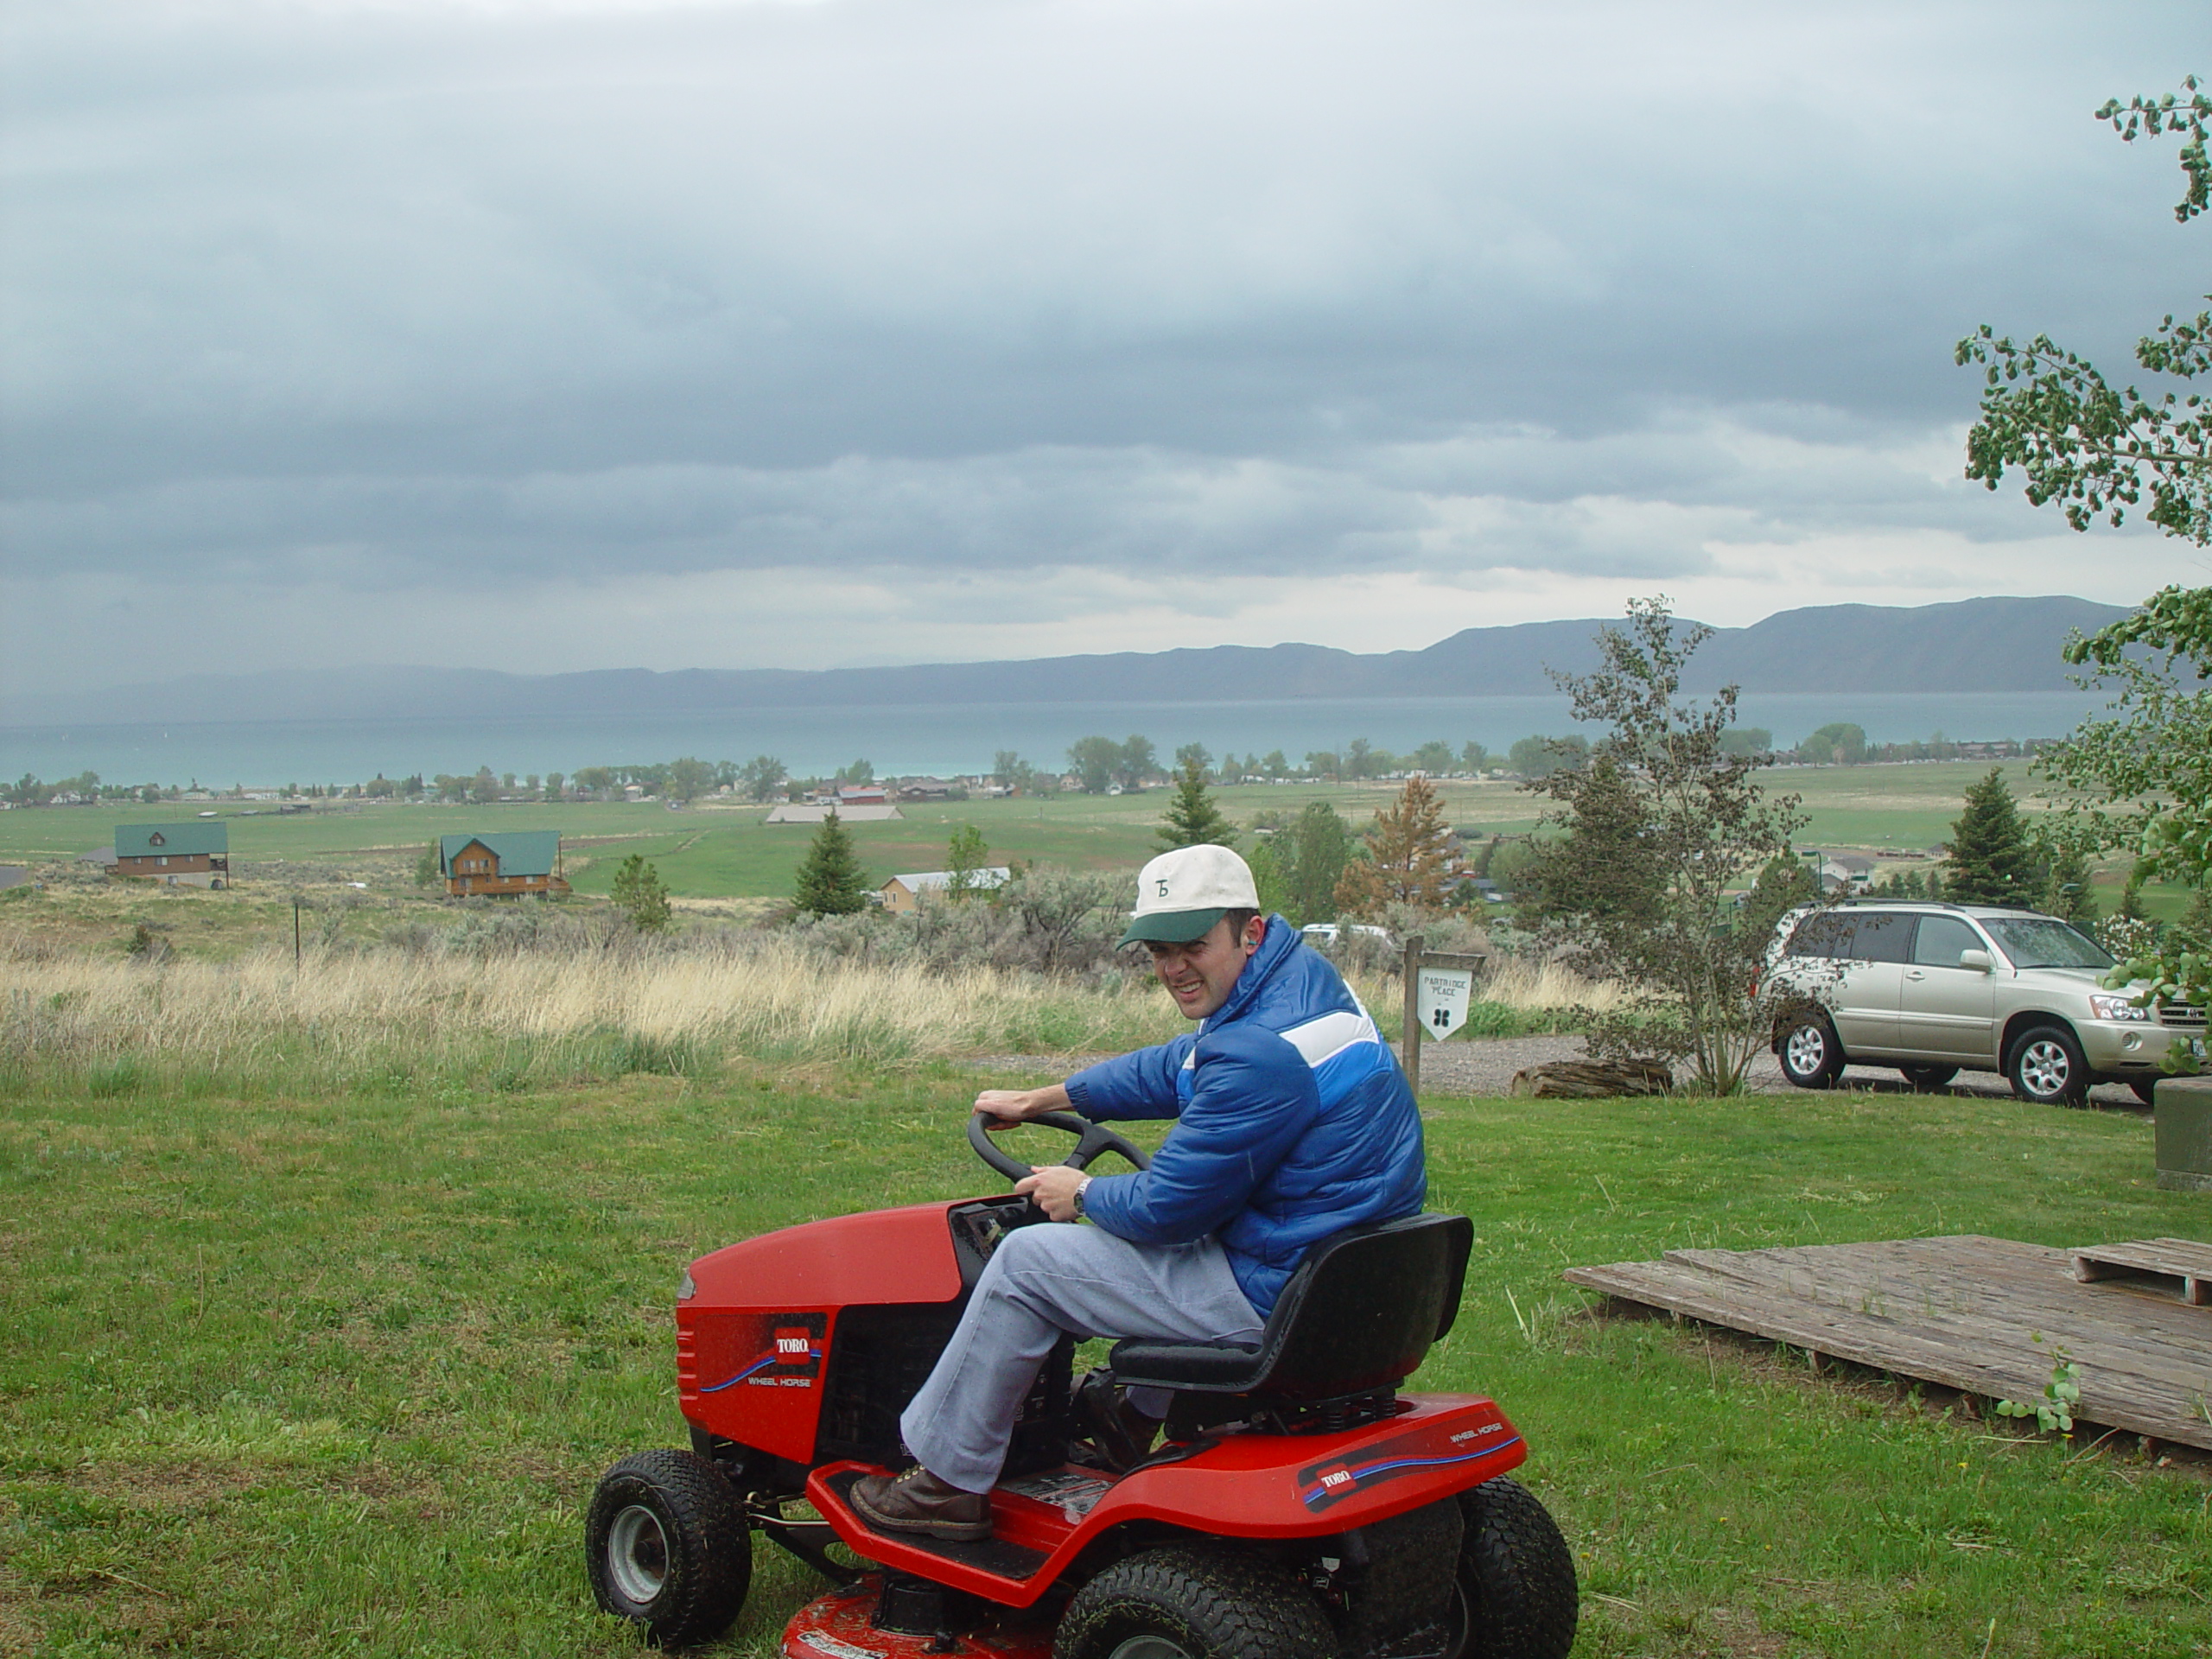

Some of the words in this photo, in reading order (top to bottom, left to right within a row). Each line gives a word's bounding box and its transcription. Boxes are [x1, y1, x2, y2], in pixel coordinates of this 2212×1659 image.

[1424, 976, 1466, 989] PARTRIDGE
[777, 1338, 810, 1353] TORO
[747, 1376, 778, 1387] WHEEL
[779, 1378, 811, 1388] HORSE
[1449, 1429, 1478, 1443] WHEEL
[1477, 1422, 1503, 1436] HORSE
[1320, 1470, 1352, 1489] TORO
